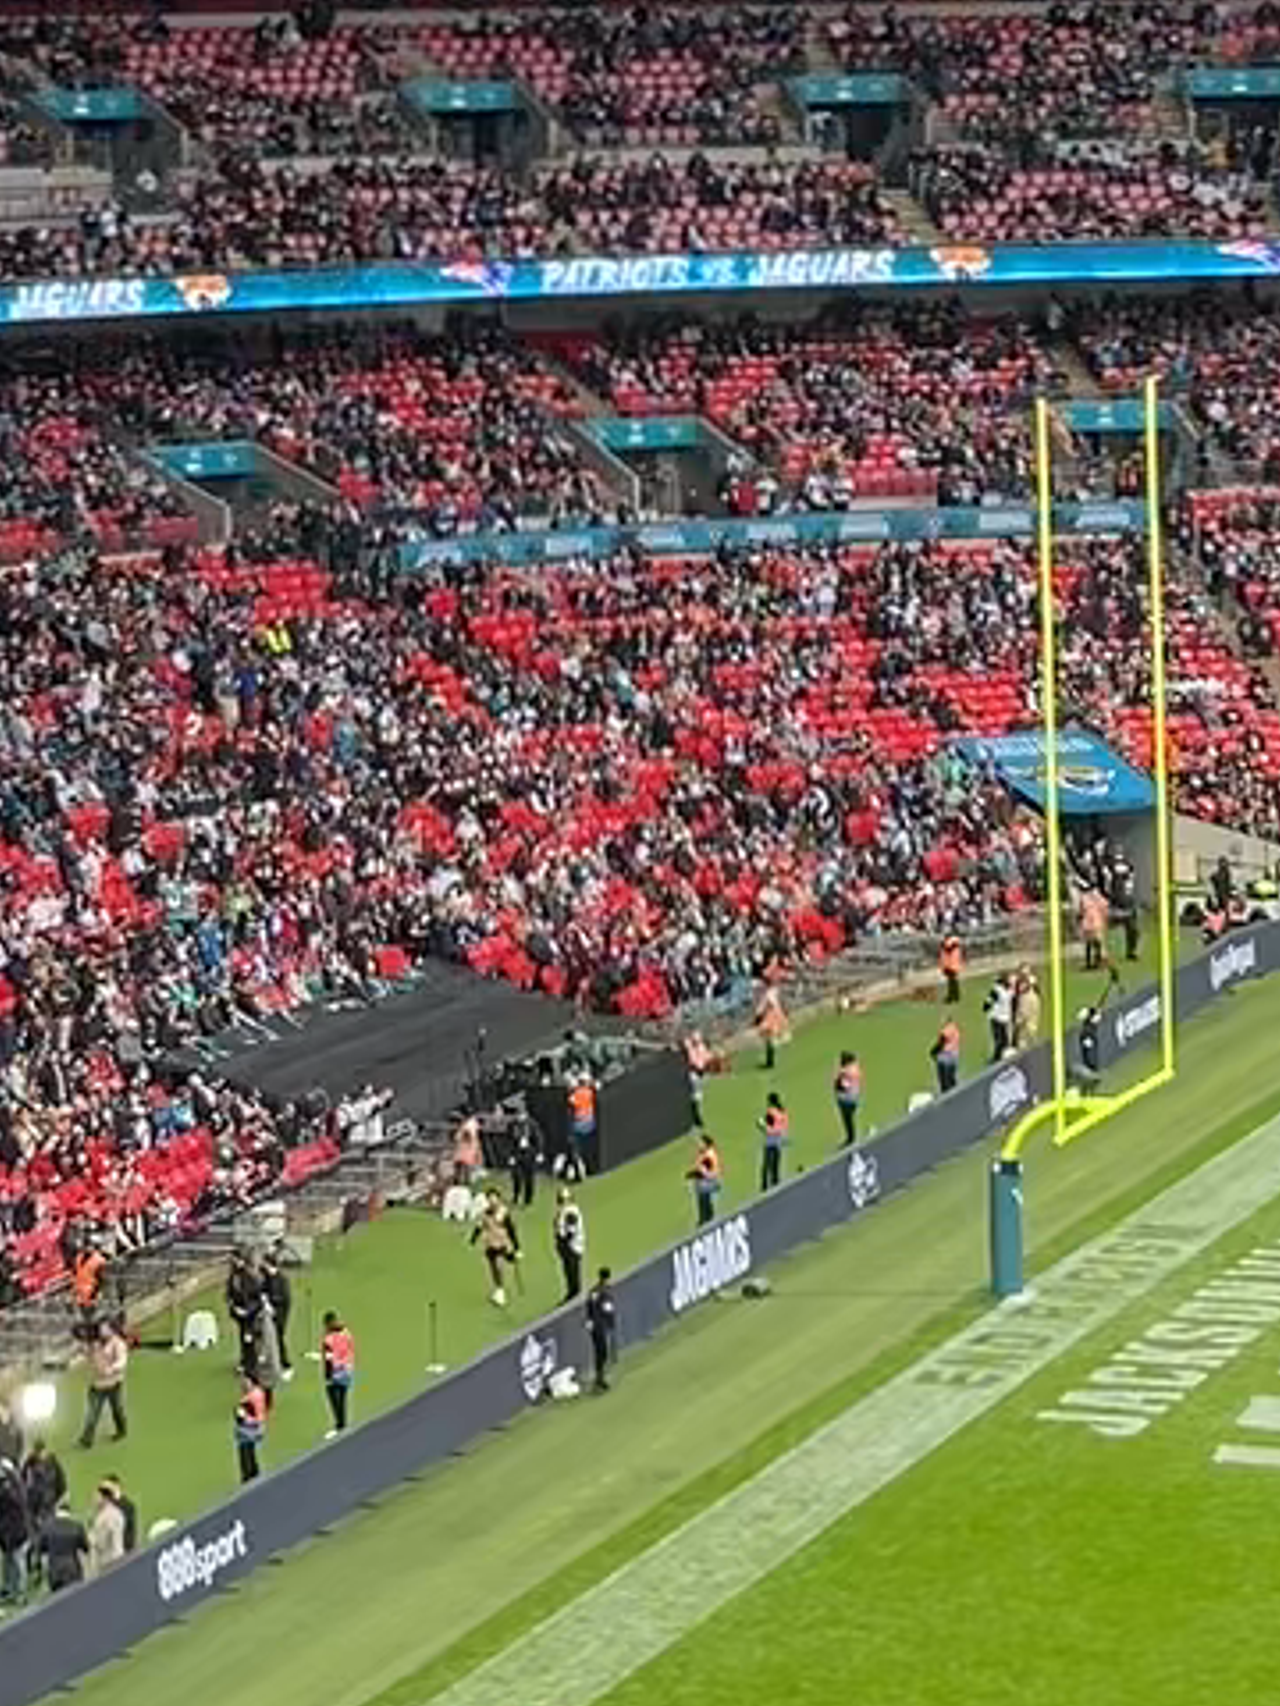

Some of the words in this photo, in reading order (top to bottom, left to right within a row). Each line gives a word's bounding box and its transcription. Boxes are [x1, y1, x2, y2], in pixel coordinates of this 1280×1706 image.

[540, 257, 690, 293] PATRIOTS
[749, 251, 896, 285] JAGUARS
[10, 280, 144, 322] JAGUARS
[158, 1519, 247, 1602] 888sport
